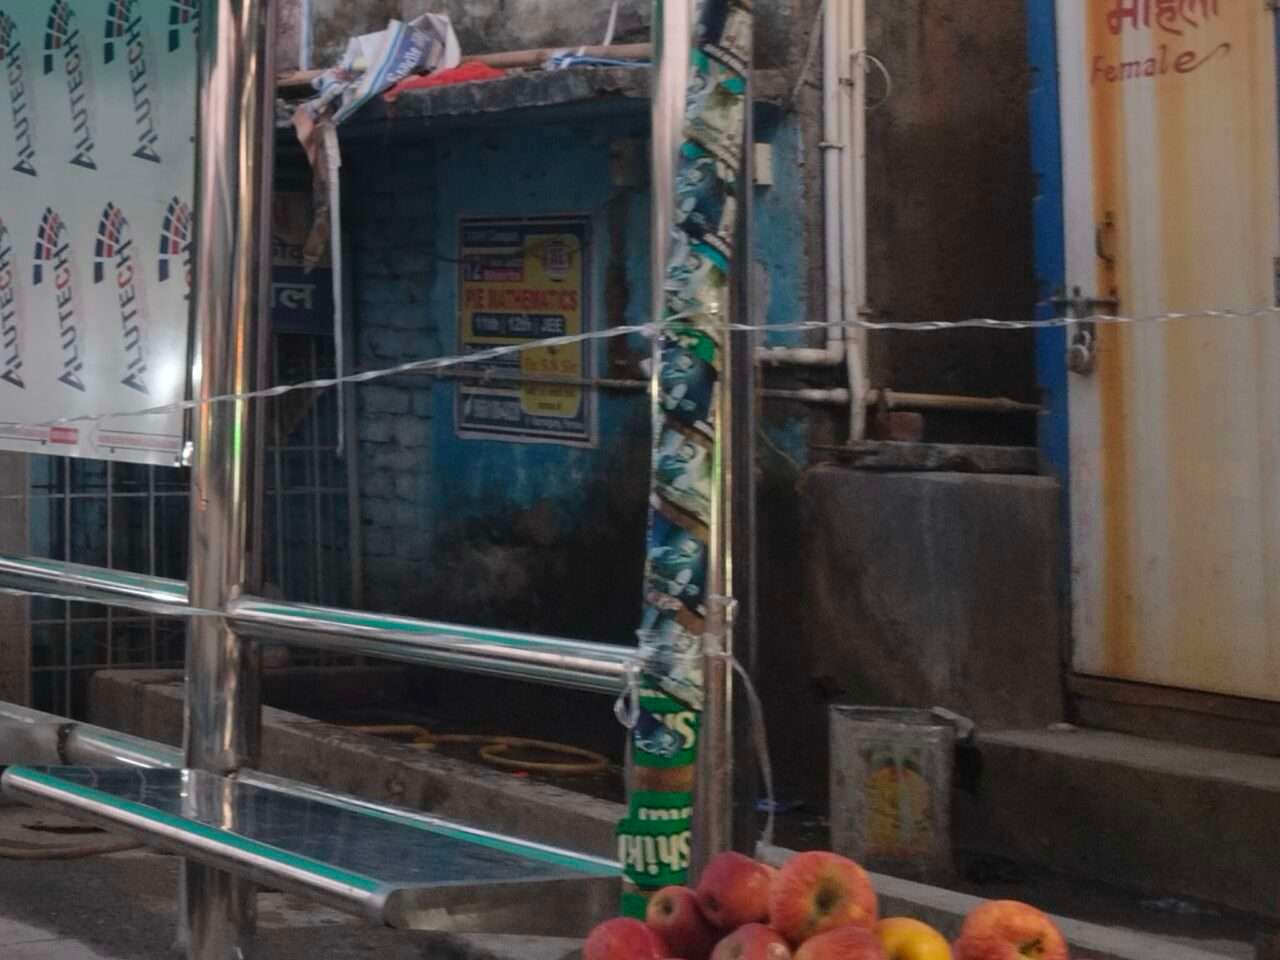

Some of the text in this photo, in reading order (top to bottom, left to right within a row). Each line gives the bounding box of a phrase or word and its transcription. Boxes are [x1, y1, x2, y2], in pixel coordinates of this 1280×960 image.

[6, 40, 39, 177] ALUTECH
[62, 28, 98, 170] ALUTECH
[124, 15, 162, 164] ALUTECH
[1090, 42, 1231, 84] Female
[52, 241, 87, 393] ALUTECH
[114, 238, 151, 395] ALUTECH
